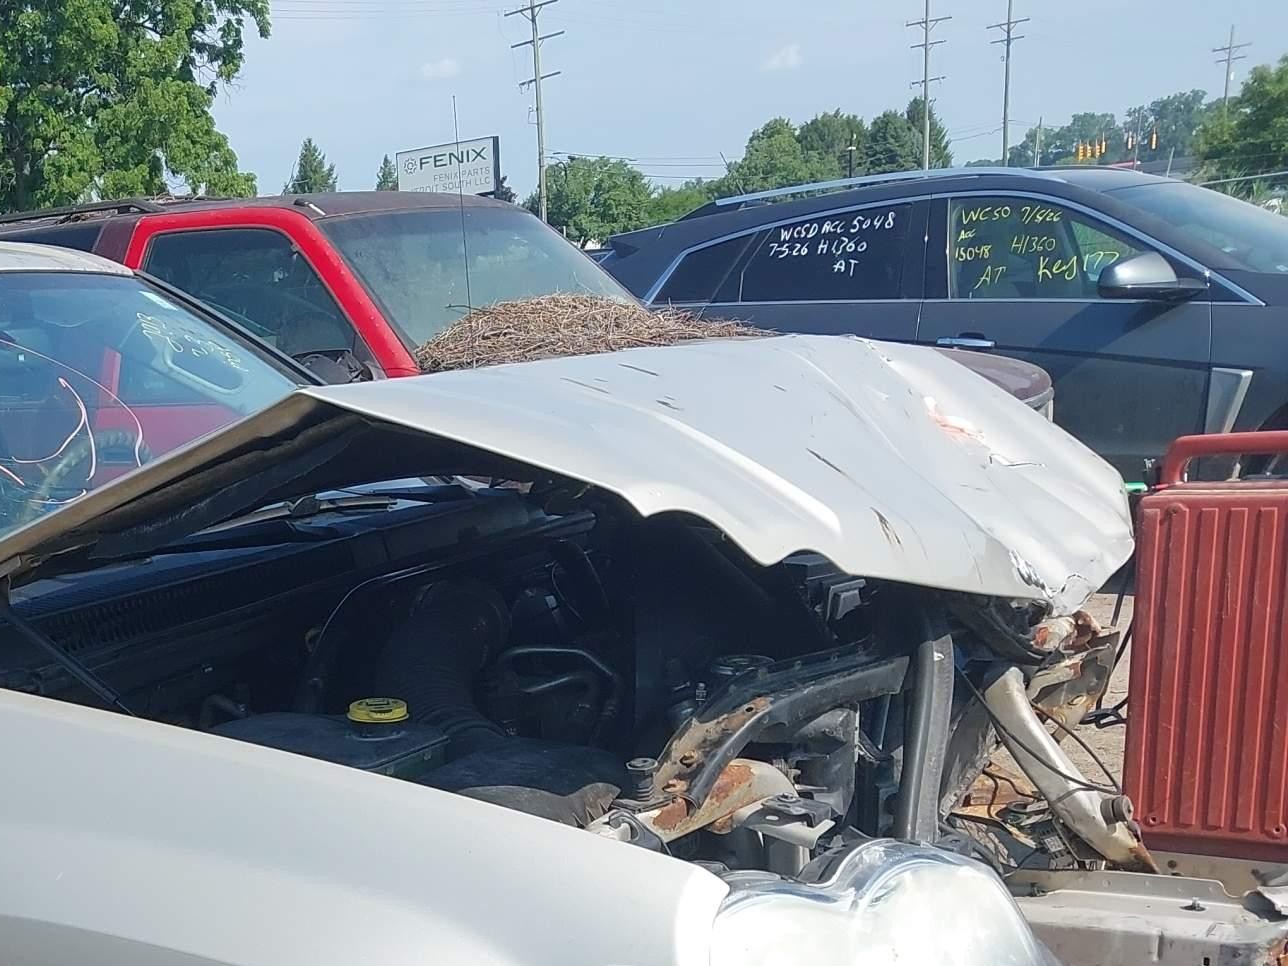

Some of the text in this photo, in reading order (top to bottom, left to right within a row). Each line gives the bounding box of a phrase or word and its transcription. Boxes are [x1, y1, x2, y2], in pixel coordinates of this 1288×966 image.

[419, 147, 487, 171] FENIX
[433, 166, 490, 183] FENIX PARTS
[442, 179, 472, 191] SOUTH
[475, 176, 490, 186] LLC
[850, 211, 896, 233] 5048
[832, 259, 859, 276] AT
[974, 266, 1006, 289] AT
